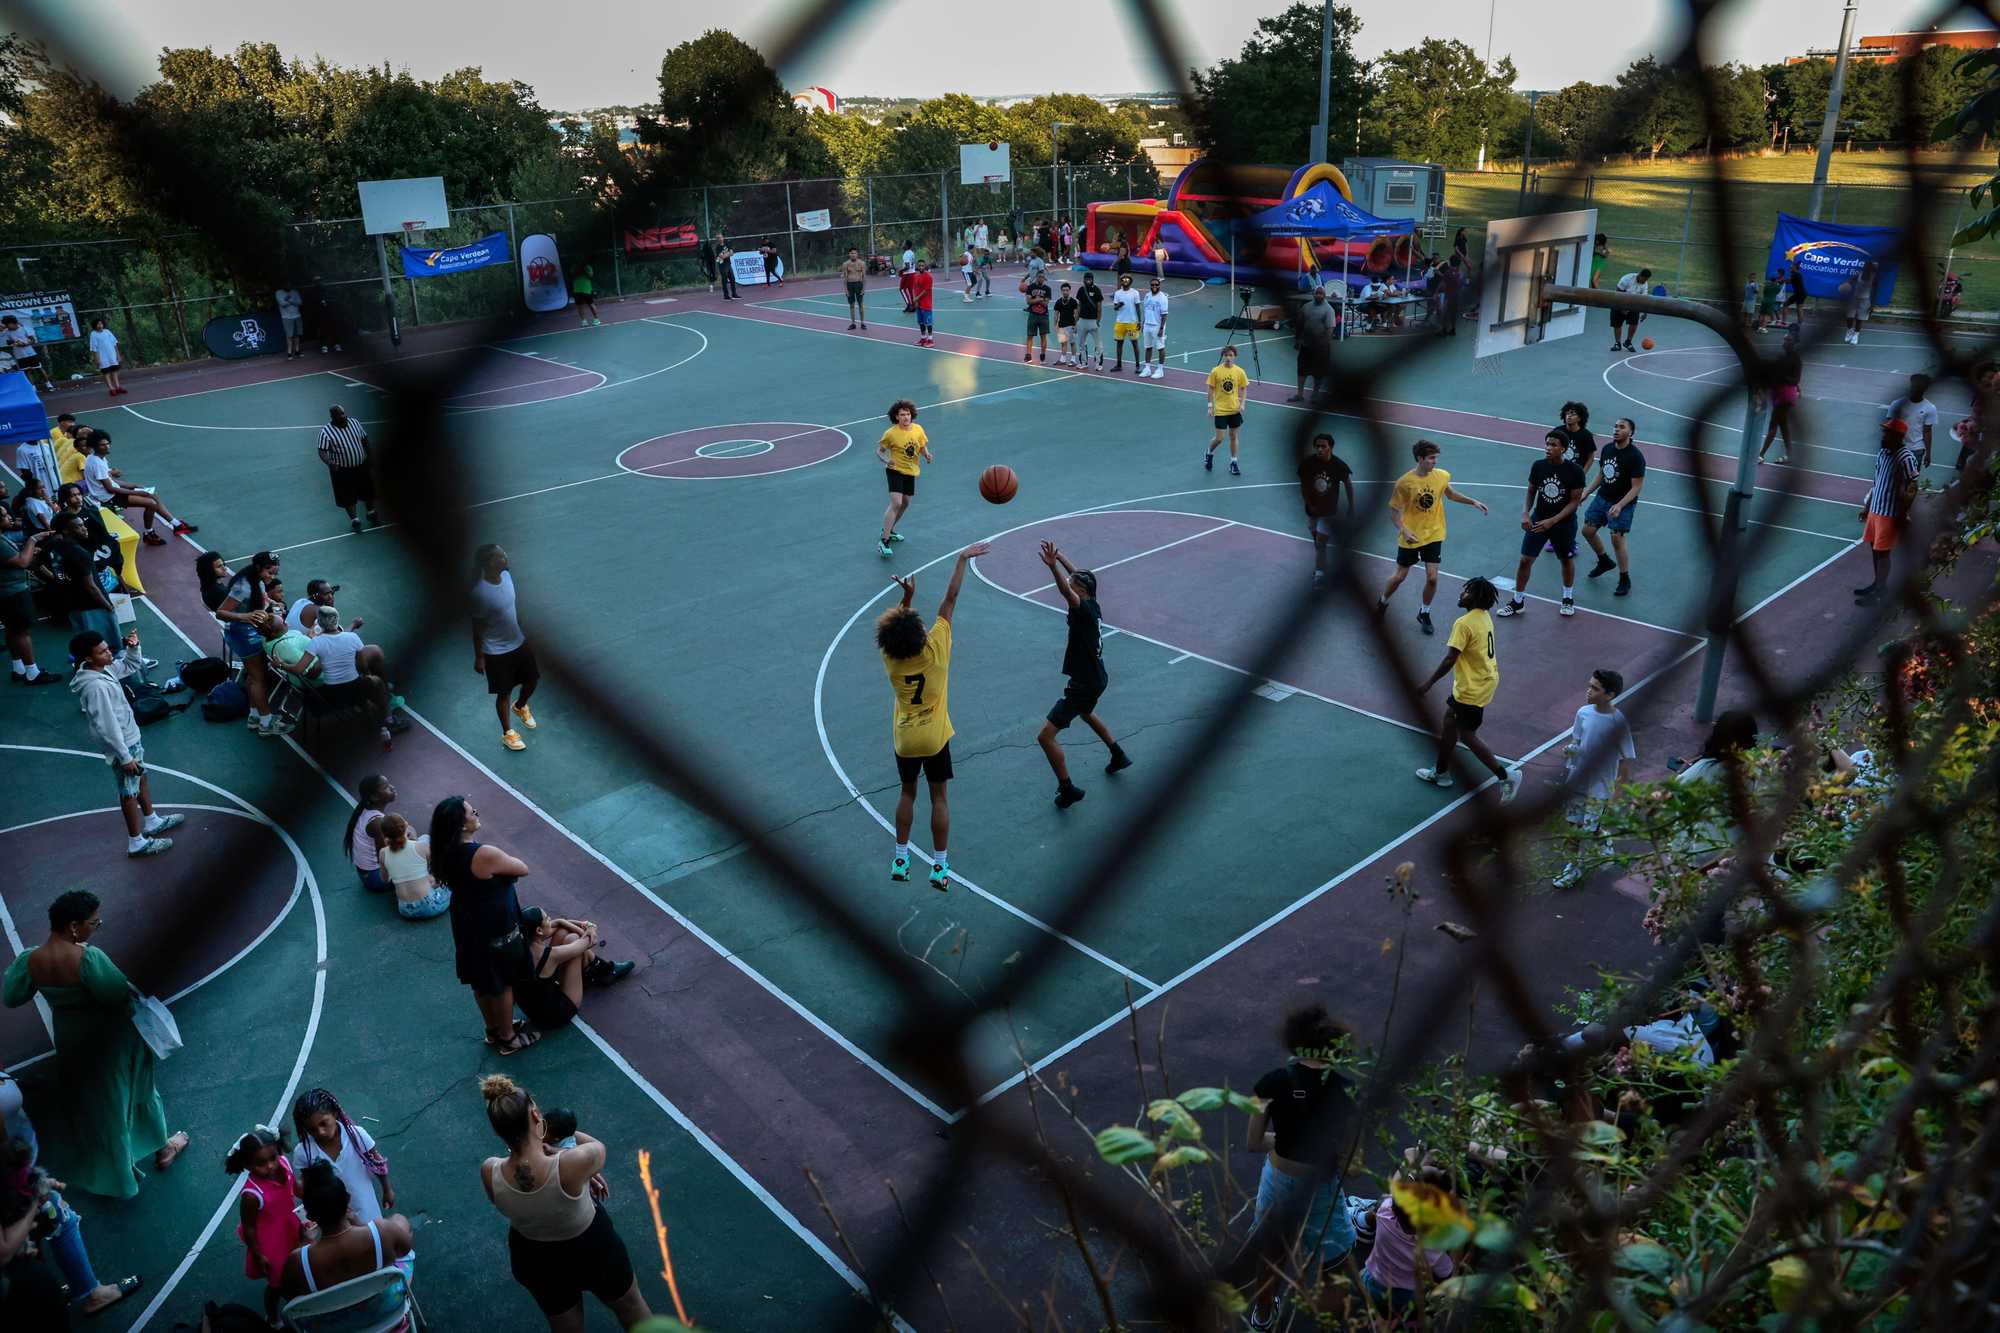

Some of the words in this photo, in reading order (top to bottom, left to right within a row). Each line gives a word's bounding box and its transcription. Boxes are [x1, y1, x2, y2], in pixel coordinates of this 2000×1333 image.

[440, 255, 459, 264] Cape
[460, 249, 489, 260] Verdean
[1804, 252, 1831, 266] Cape
[1833, 256, 1866, 269] Verde
[1840, 267, 1849, 275] of
[43, 293, 72, 305] SLAM
[1487, 631, 1495, 659] 0
[904, 672, 926, 705] 7
